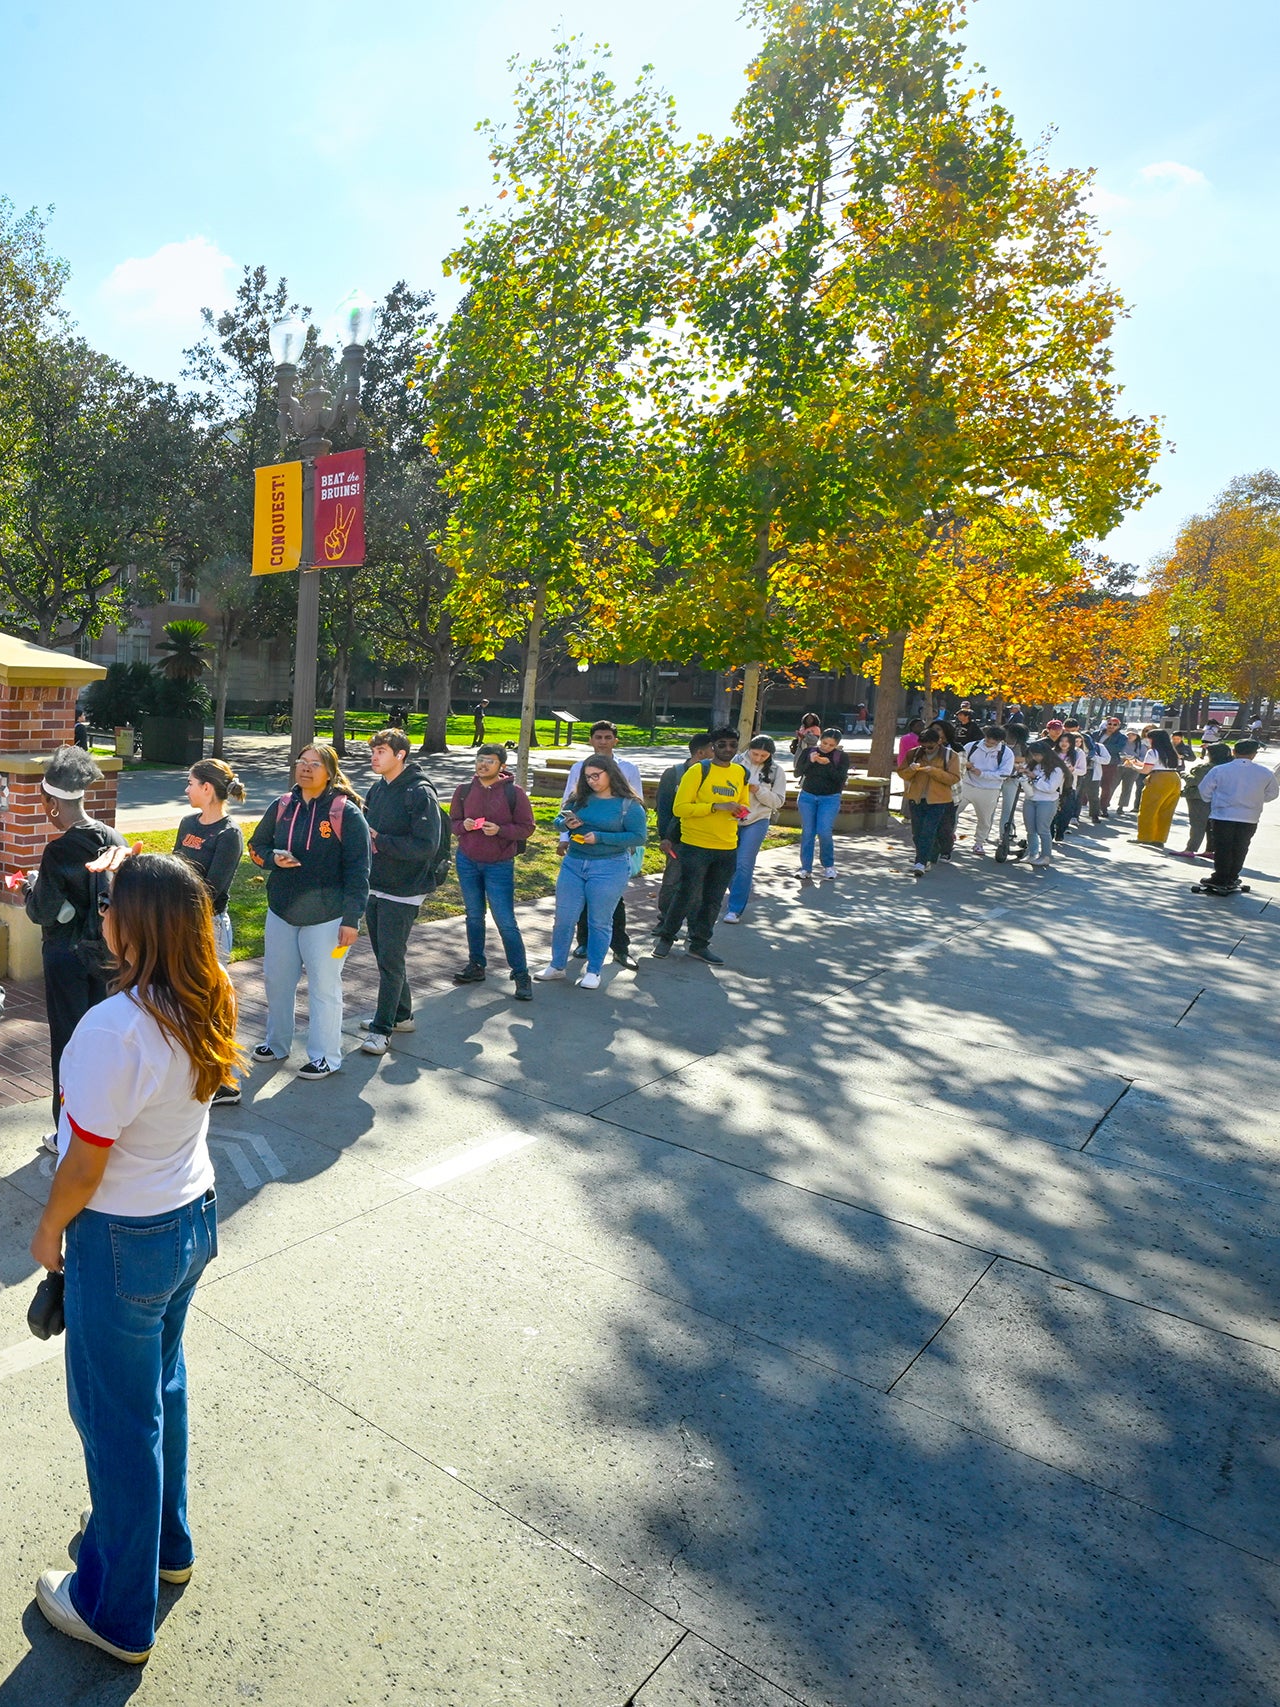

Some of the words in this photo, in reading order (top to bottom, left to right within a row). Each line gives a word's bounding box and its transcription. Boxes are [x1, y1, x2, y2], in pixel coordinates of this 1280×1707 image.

[321, 472, 345, 487] BEAT
[347, 471, 360, 483] the
[321, 483, 360, 500] BRUINS!
[270, 474, 286, 567] CONQUEST!
